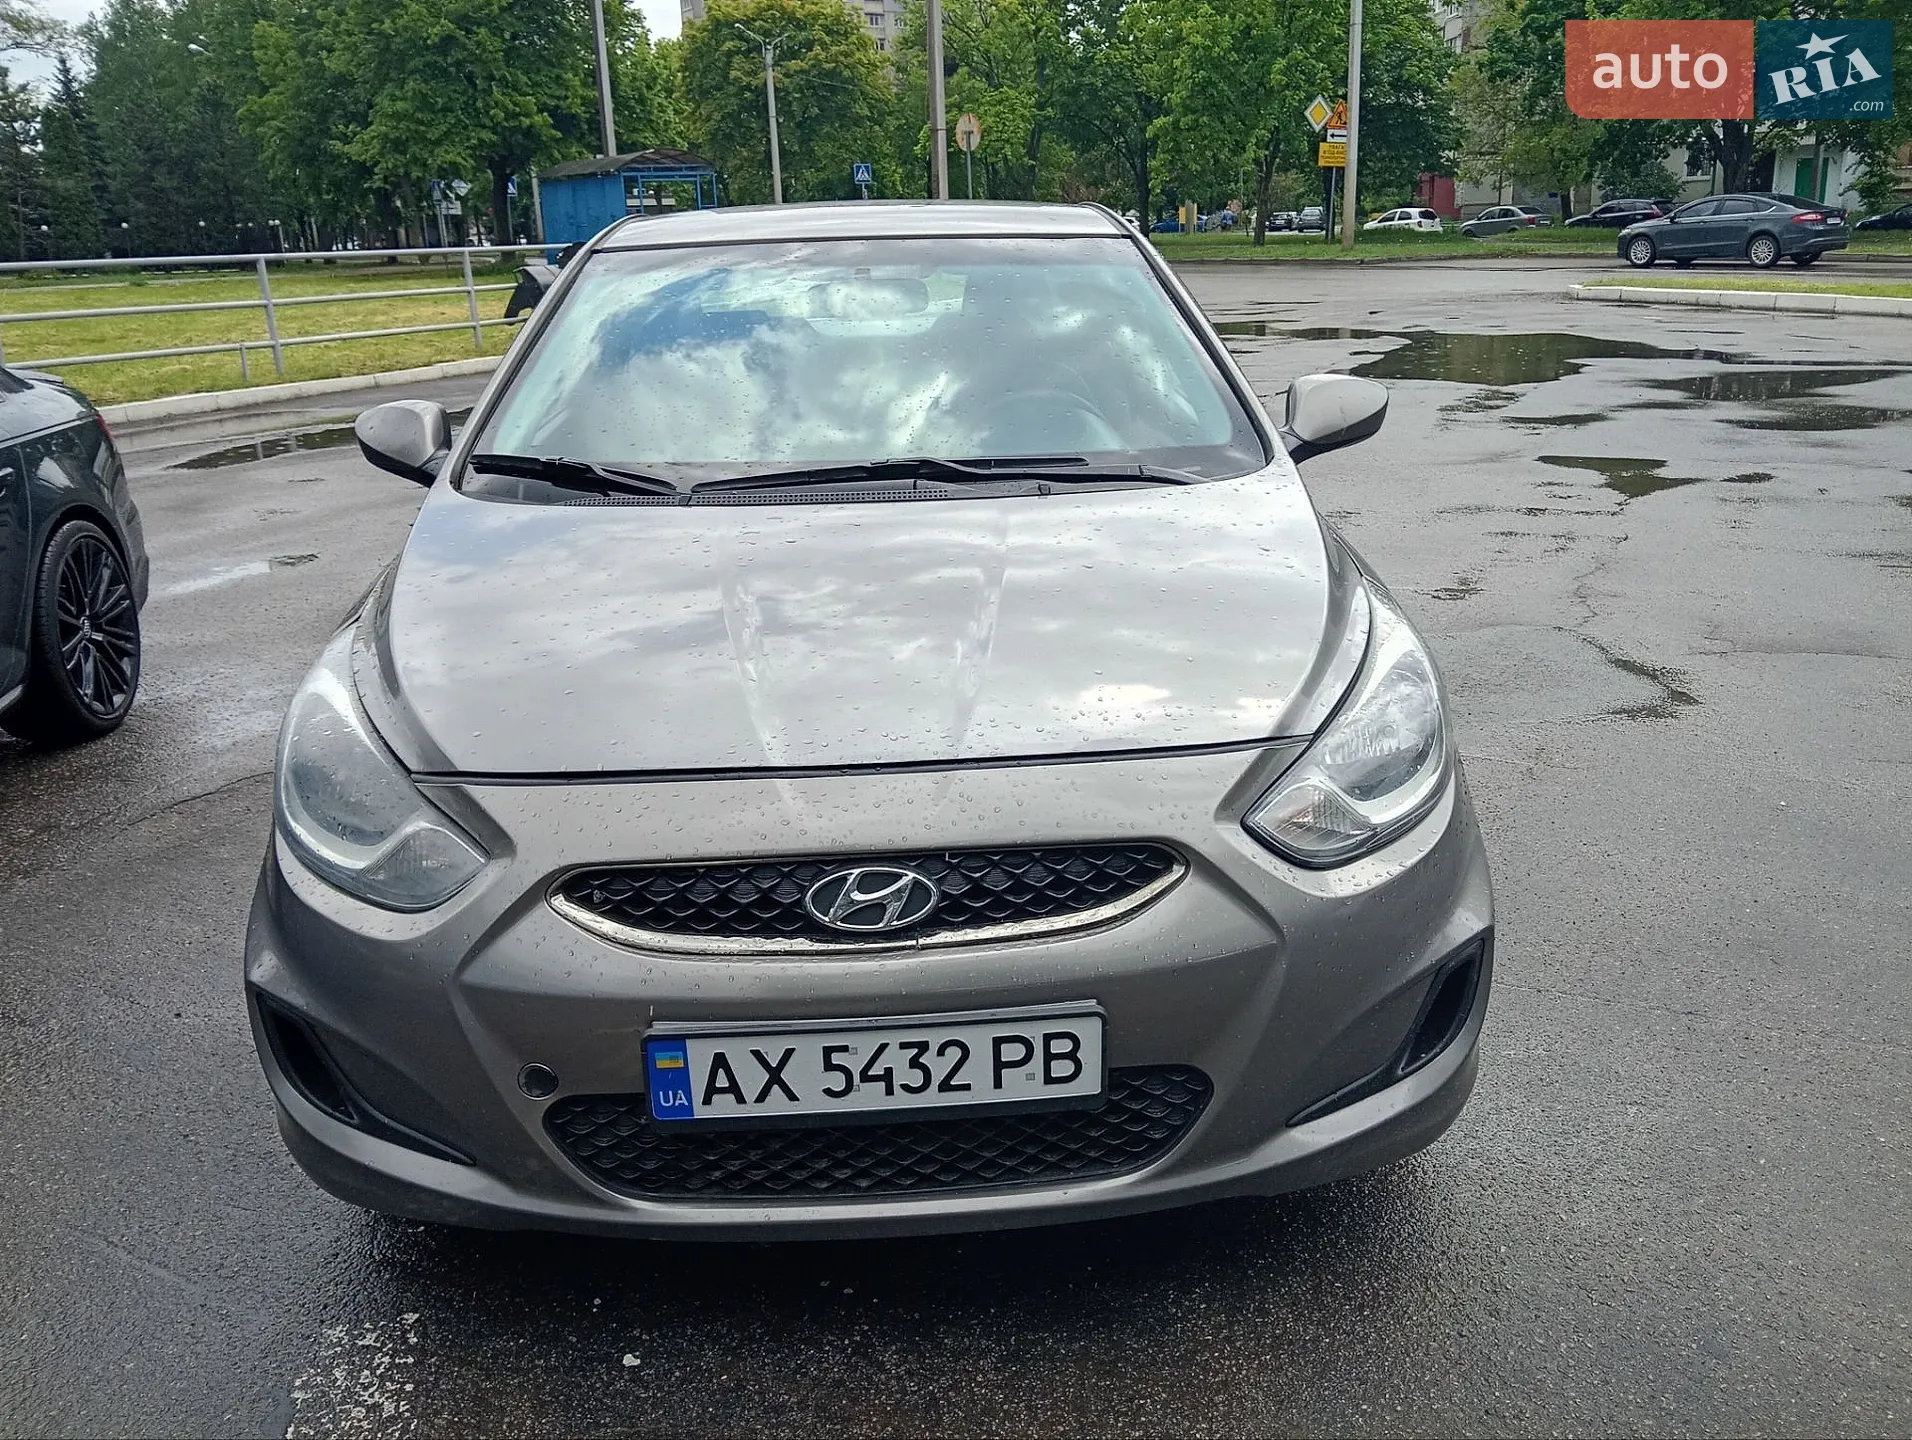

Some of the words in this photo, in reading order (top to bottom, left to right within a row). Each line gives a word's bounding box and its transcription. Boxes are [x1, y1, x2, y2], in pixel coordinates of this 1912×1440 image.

[701, 1047, 801, 1107] AX
[821, 1038, 972, 1099] 5432
[991, 1030, 1084, 1090] PB
[658, 1090, 689, 1107] UA
